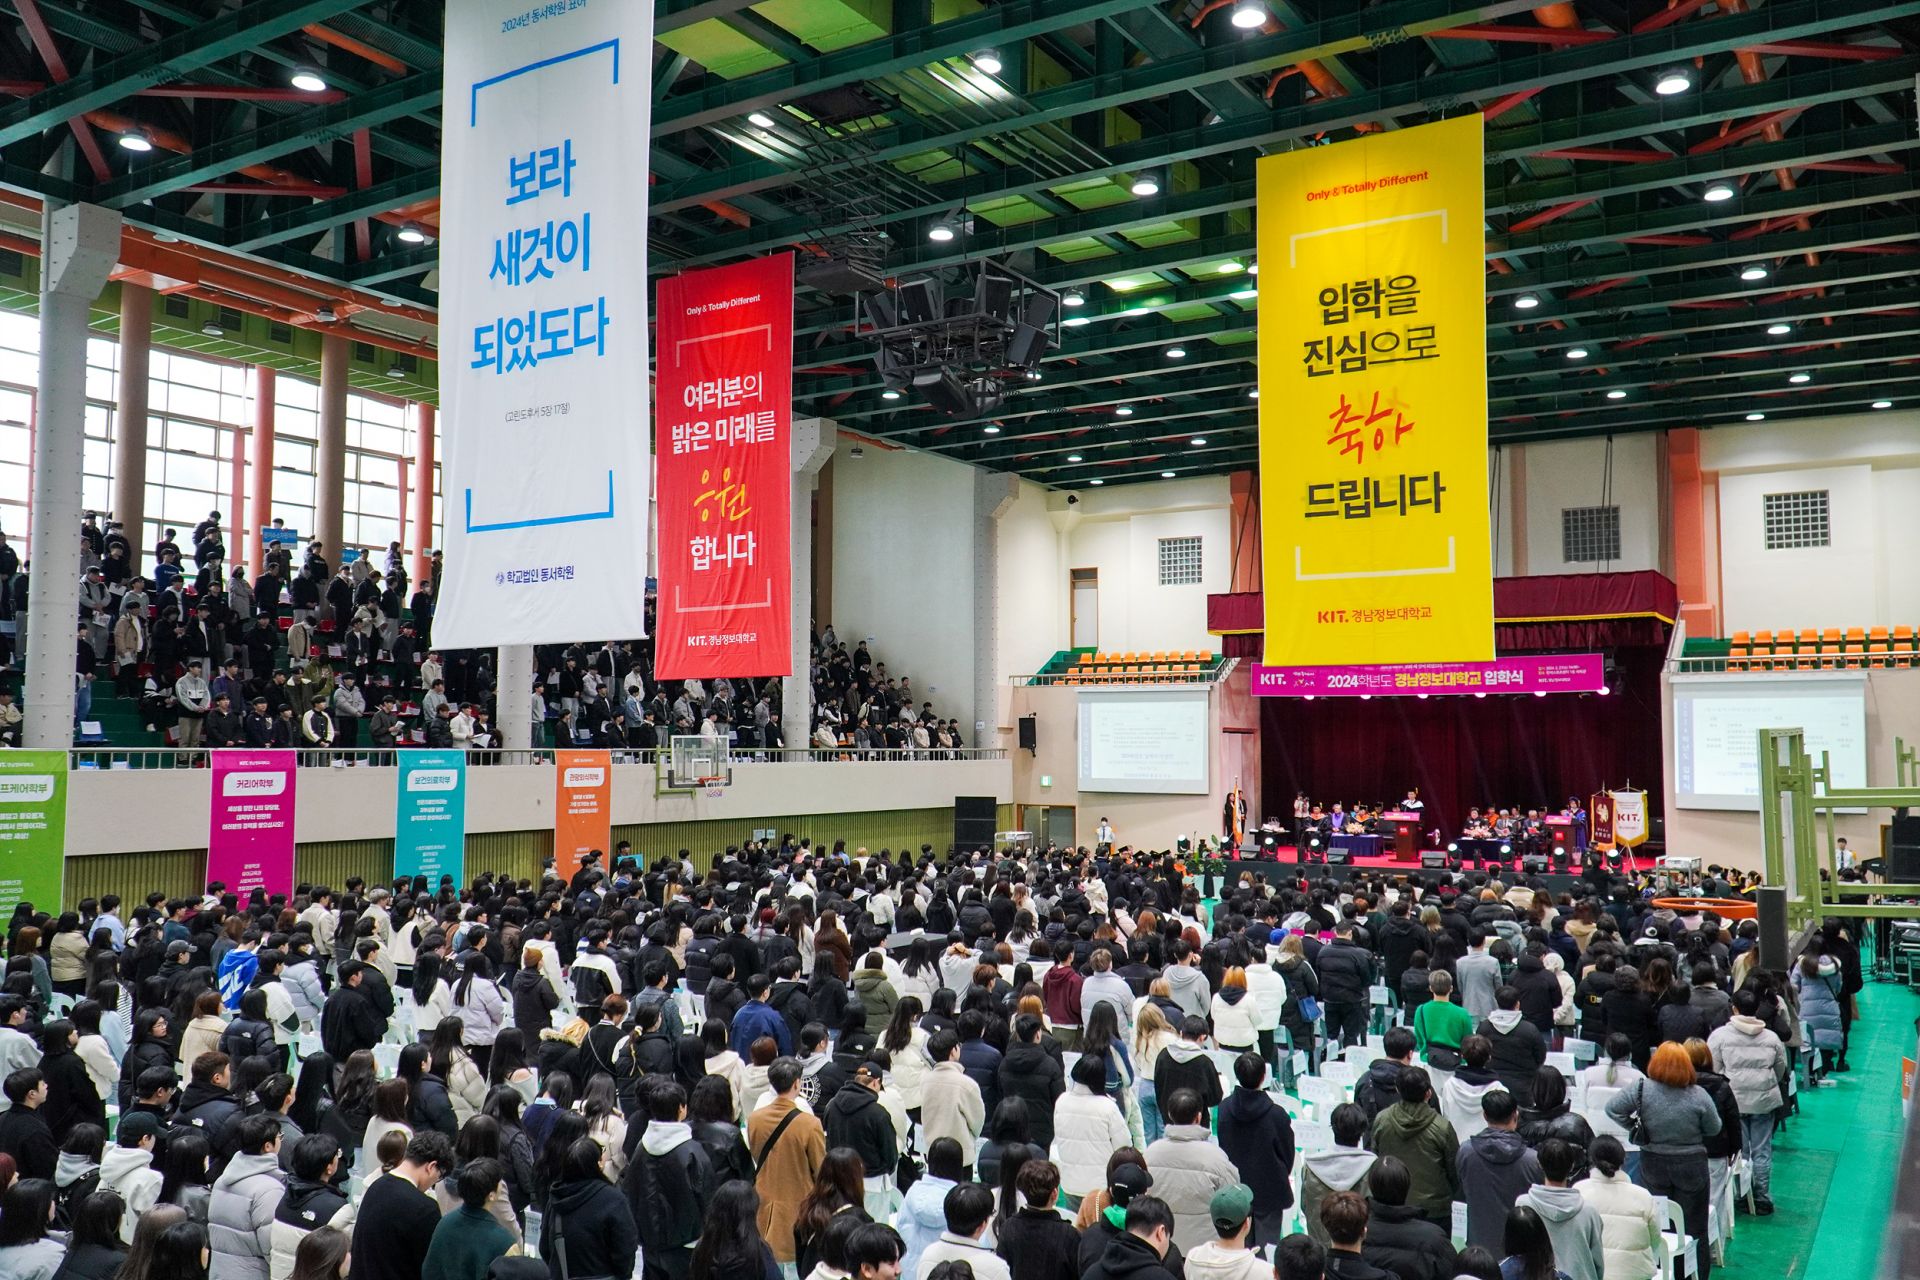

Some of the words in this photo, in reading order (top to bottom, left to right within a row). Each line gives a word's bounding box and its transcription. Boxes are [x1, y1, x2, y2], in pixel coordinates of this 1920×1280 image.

[502, 12, 529, 33] 2024년
[531, 0, 566, 23] 동서학원
[506, 138, 577, 206] 보라
[1306, 189, 1330, 202] Only
[1332, 187, 1341, 197] &
[1341, 181, 1377, 196] Totally
[1379, 170, 1429, 189] Different
[489, 212, 591, 287] 새것이
[686, 306, 702, 316] Only
[702, 304, 707, 313] &
[708, 299, 730, 312] Totally
[730, 294, 761, 307] Different
[1318, 275, 1421, 326] 입학을
[470, 296, 610, 375] 되었도다
[1303, 325, 1441, 378] 진심으로
[684, 371, 763, 412] 여러분의
[504, 407, 540, 423] (고린도후서
[540, 404, 553, 417] 5장
[554, 402, 571, 416] 17절)
[1326, 390, 1416, 465] 축하
[671, 421, 712, 455] 밝은
[715, 410, 777, 447] 미래를
[693, 467, 752, 522] 응원
[1304, 471, 1446, 520] 드립니다
[689, 530, 757, 571] 합니다
[507, 568, 539, 584] 학교법인
[540, 565, 575, 582] 동서학원
[1317, 610, 1349, 624] KIT.
[1351, 606, 1433, 623] 경남정보대학교
[687, 635, 708, 647] KIT.
[708, 632, 757, 646] 경남정보대학교
[1260, 673, 1287, 685] KIT.
[1327, 674, 1392, 688] 2024학년도
[1394, 671, 1482, 688] 경남정보대학교
[1484, 670, 1524, 685] 입학식
[235, 779, 274, 788] 커리어학부
[414, 775, 451, 785] 보건의료학부
[1617, 813, 1641, 822] KIT.
